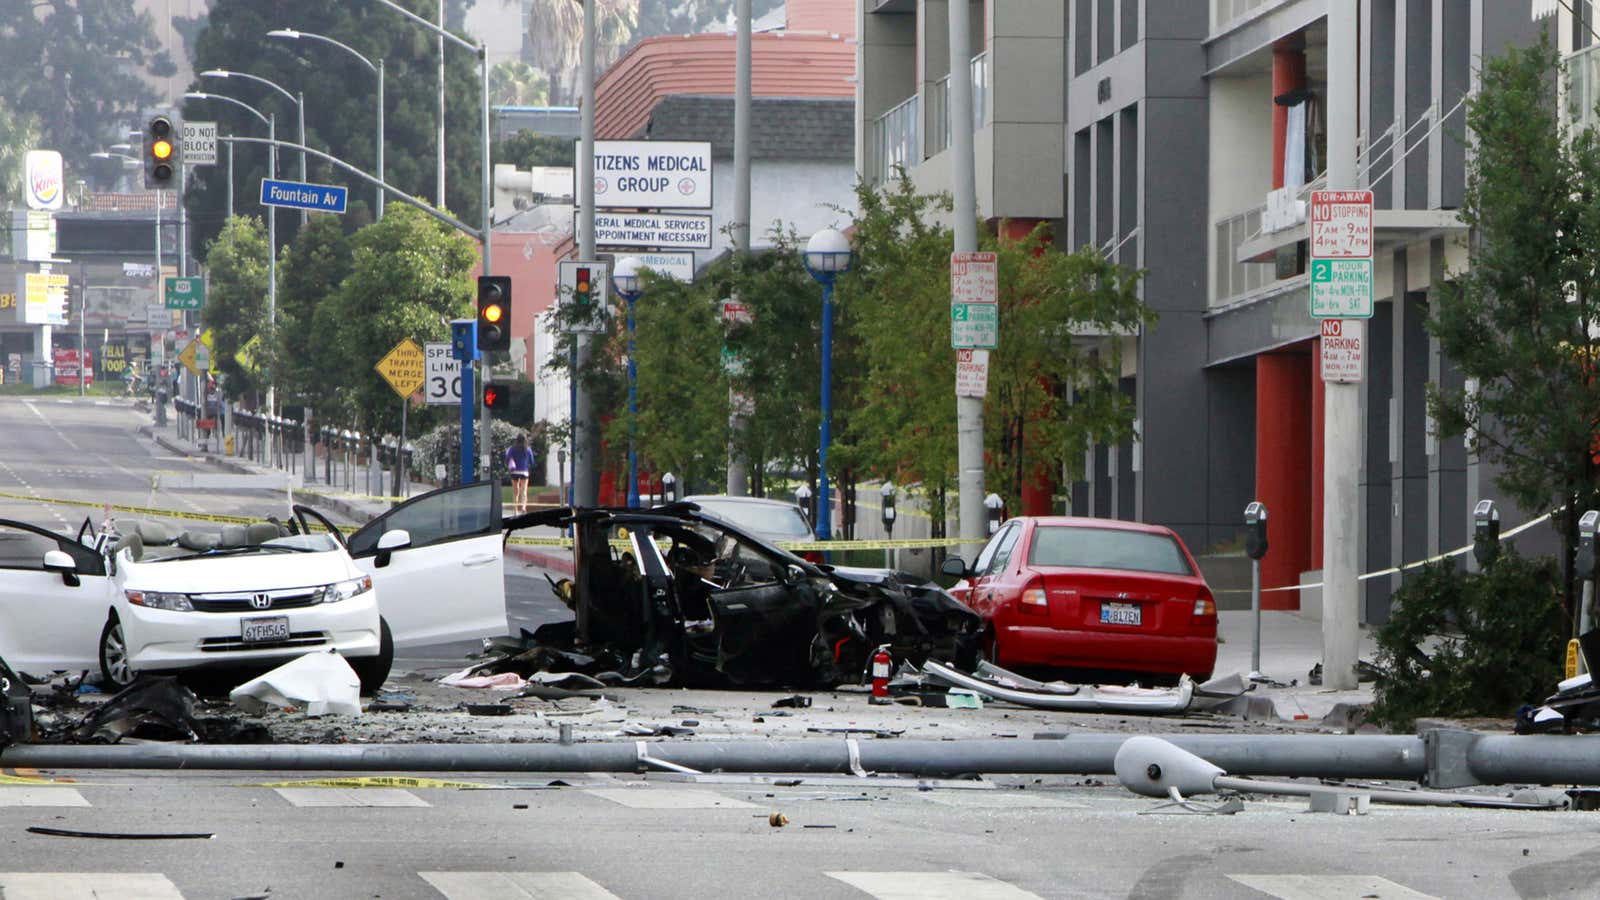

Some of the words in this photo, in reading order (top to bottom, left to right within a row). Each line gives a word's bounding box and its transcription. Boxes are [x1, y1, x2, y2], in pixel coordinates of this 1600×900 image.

[184, 127, 196, 138] DO
[199, 127, 215, 138] NOT
[184, 141, 215, 151] BLOCK
[594, 155, 640, 171] TIZENS
[647, 155, 707, 172] MEDICAL
[617, 177, 669, 193] GROUP
[270, 185, 318, 205] Fountain
[322, 191, 338, 206] Av
[1317, 191, 1366, 202] TOW-AWAY
[1313, 204, 1330, 220] NO
[1333, 205, 1369, 218] STOPPING
[595, 217, 621, 228] NERAL
[623, 218, 662, 230] MEDICAL
[664, 219, 706, 231] SERVICES
[595, 229, 656, 241] APPOINTMENT
[657, 231, 708, 243] NECESSARY
[1315, 263, 1328, 281] 2
[1332, 271, 1369, 284] PARKING
[955, 306, 964, 320] 2
[1323, 320, 1341, 336] NO
[1324, 337, 1361, 351] PARKING
[396, 349, 419, 358] THRU
[428, 348, 453, 359] SPE
[959, 350, 971, 362] NO
[388, 369, 423, 378] MERGE
[431, 362, 460, 372] LIMI
[395, 380, 418, 388] LEFT
[245, 624, 287, 638] 6YFH545
